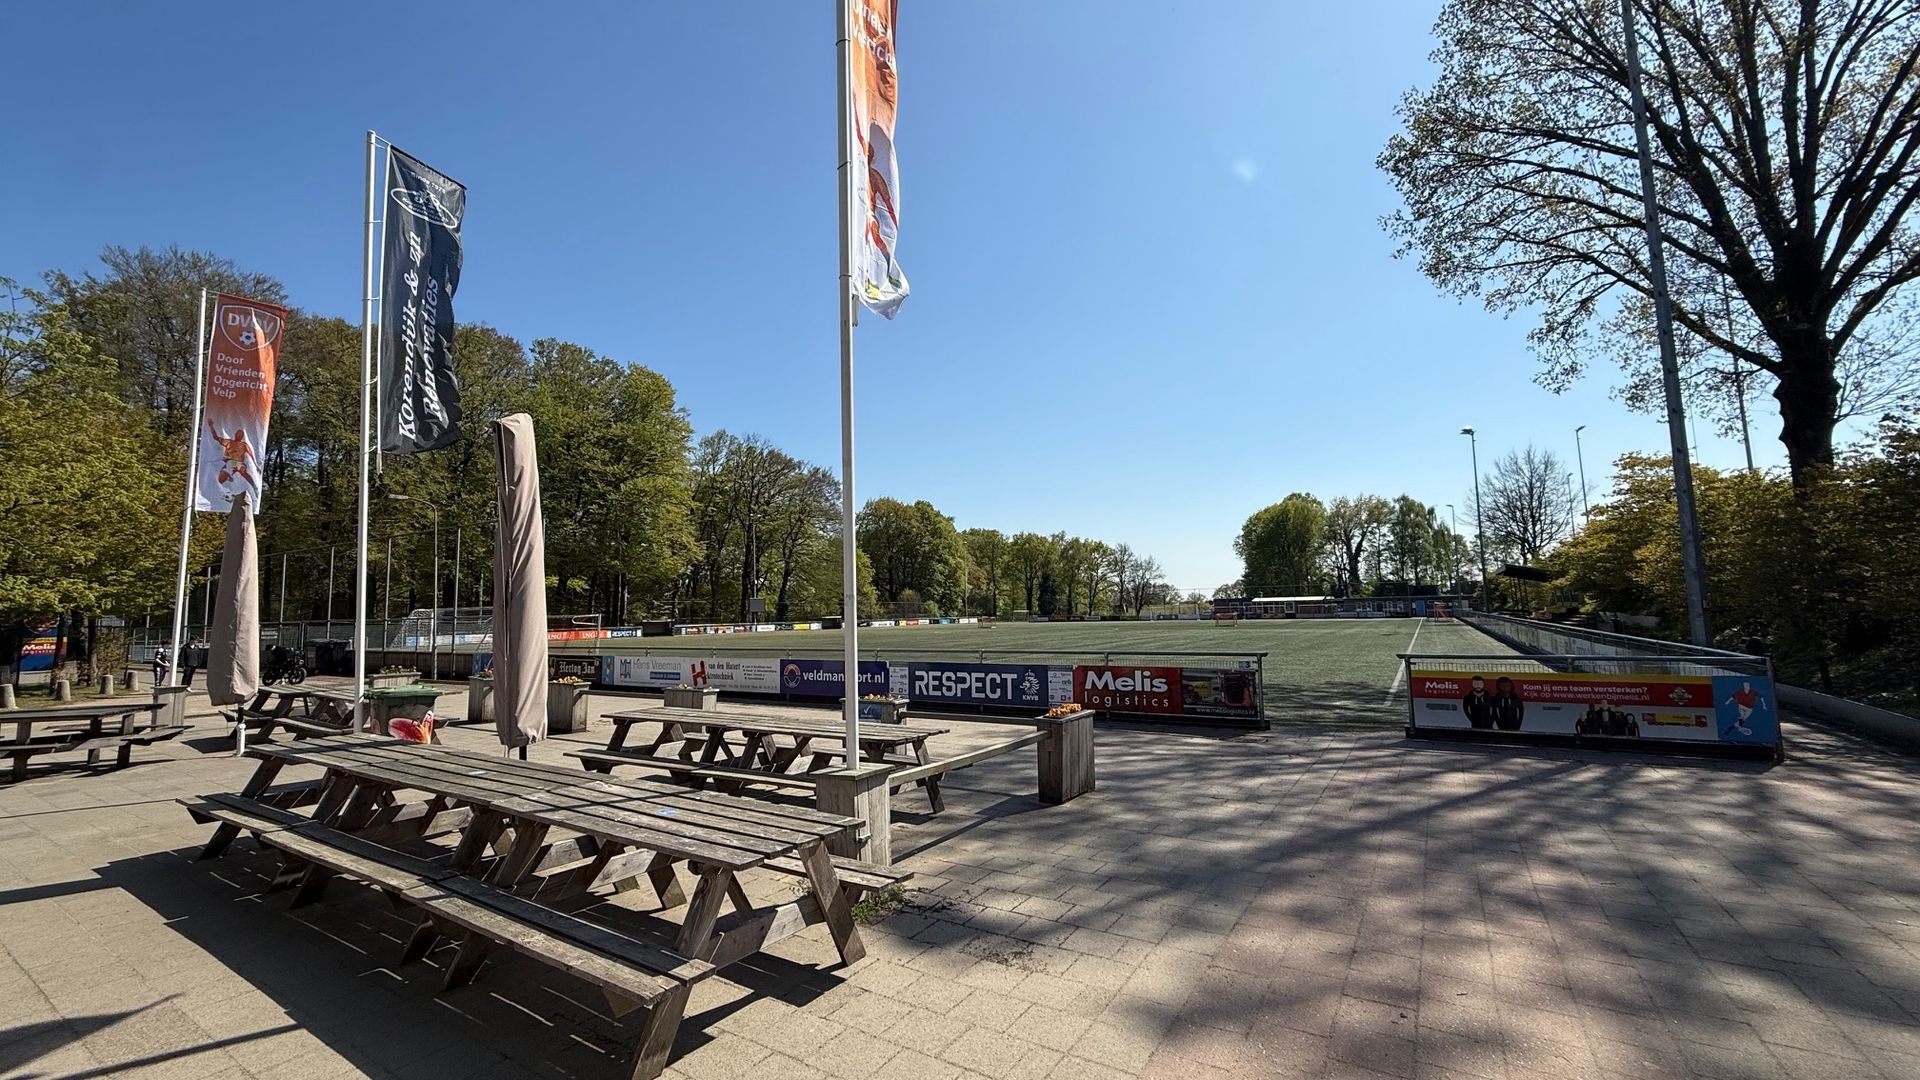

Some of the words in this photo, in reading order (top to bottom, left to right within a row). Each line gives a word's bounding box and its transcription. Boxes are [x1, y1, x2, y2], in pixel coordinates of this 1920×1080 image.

[227, 312, 274, 332] DVV
[422, 275, 443, 421] Renovaties
[217, 352, 244, 365] Door
[215, 363, 266, 379] Vrienden
[214, 375, 269, 392] Opgericht
[212, 386, 237, 400] Velp
[802, 669, 885, 684] veldmanort.nl
[1084, 669, 1168, 692] Melis
[914, 670, 1018, 700] RESPECT
[1425, 681, 1459, 690] Melis
[1522, 683, 1542, 691] Kom
[1592, 686, 1648, 694] versterken?
[1084, 691, 1169, 708] logistics
[1523, 690, 1538, 698] Kijk
